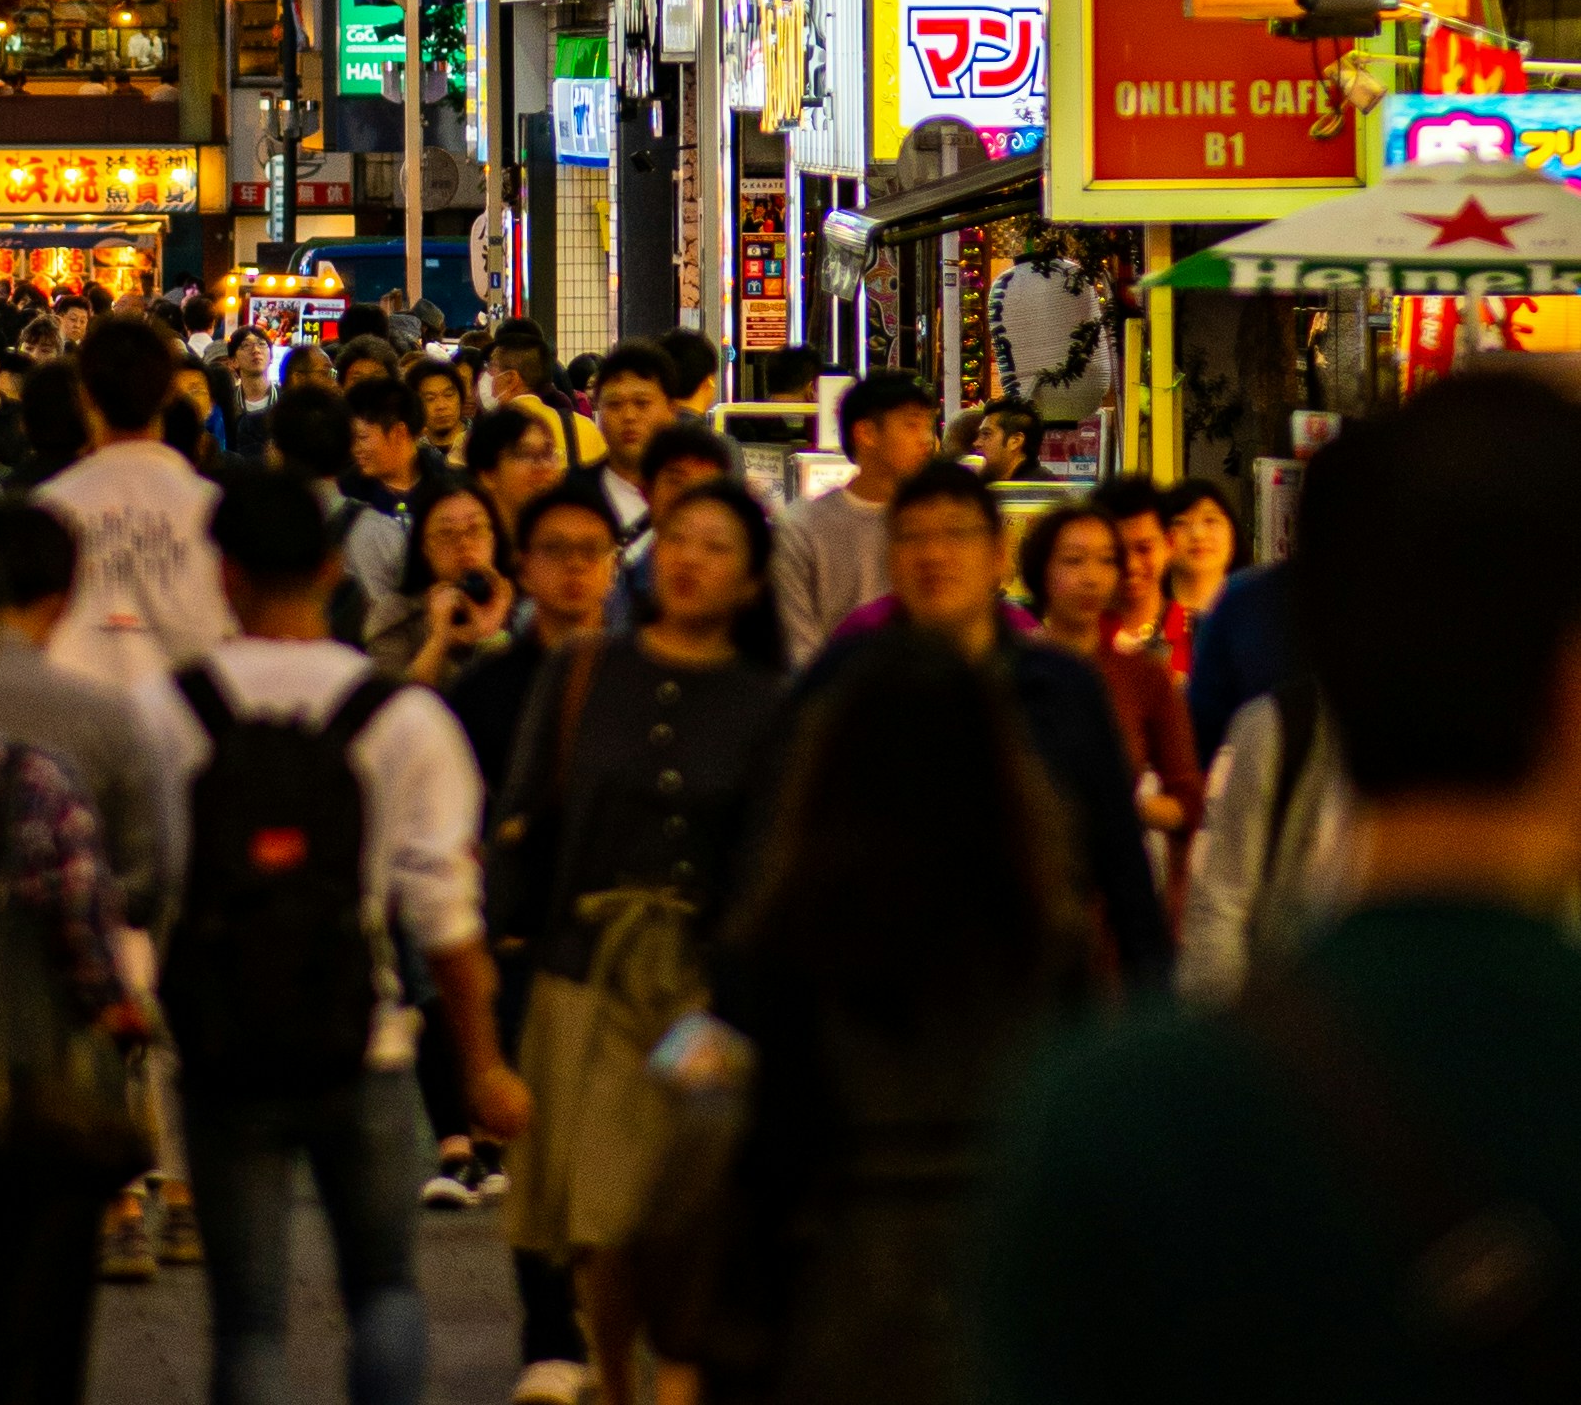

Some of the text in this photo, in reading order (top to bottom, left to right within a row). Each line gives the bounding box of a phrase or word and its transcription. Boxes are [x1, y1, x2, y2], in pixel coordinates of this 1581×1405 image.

[1114, 78, 1333, 118] ONLINE CAFE
[1204, 132, 1247, 169] B1
